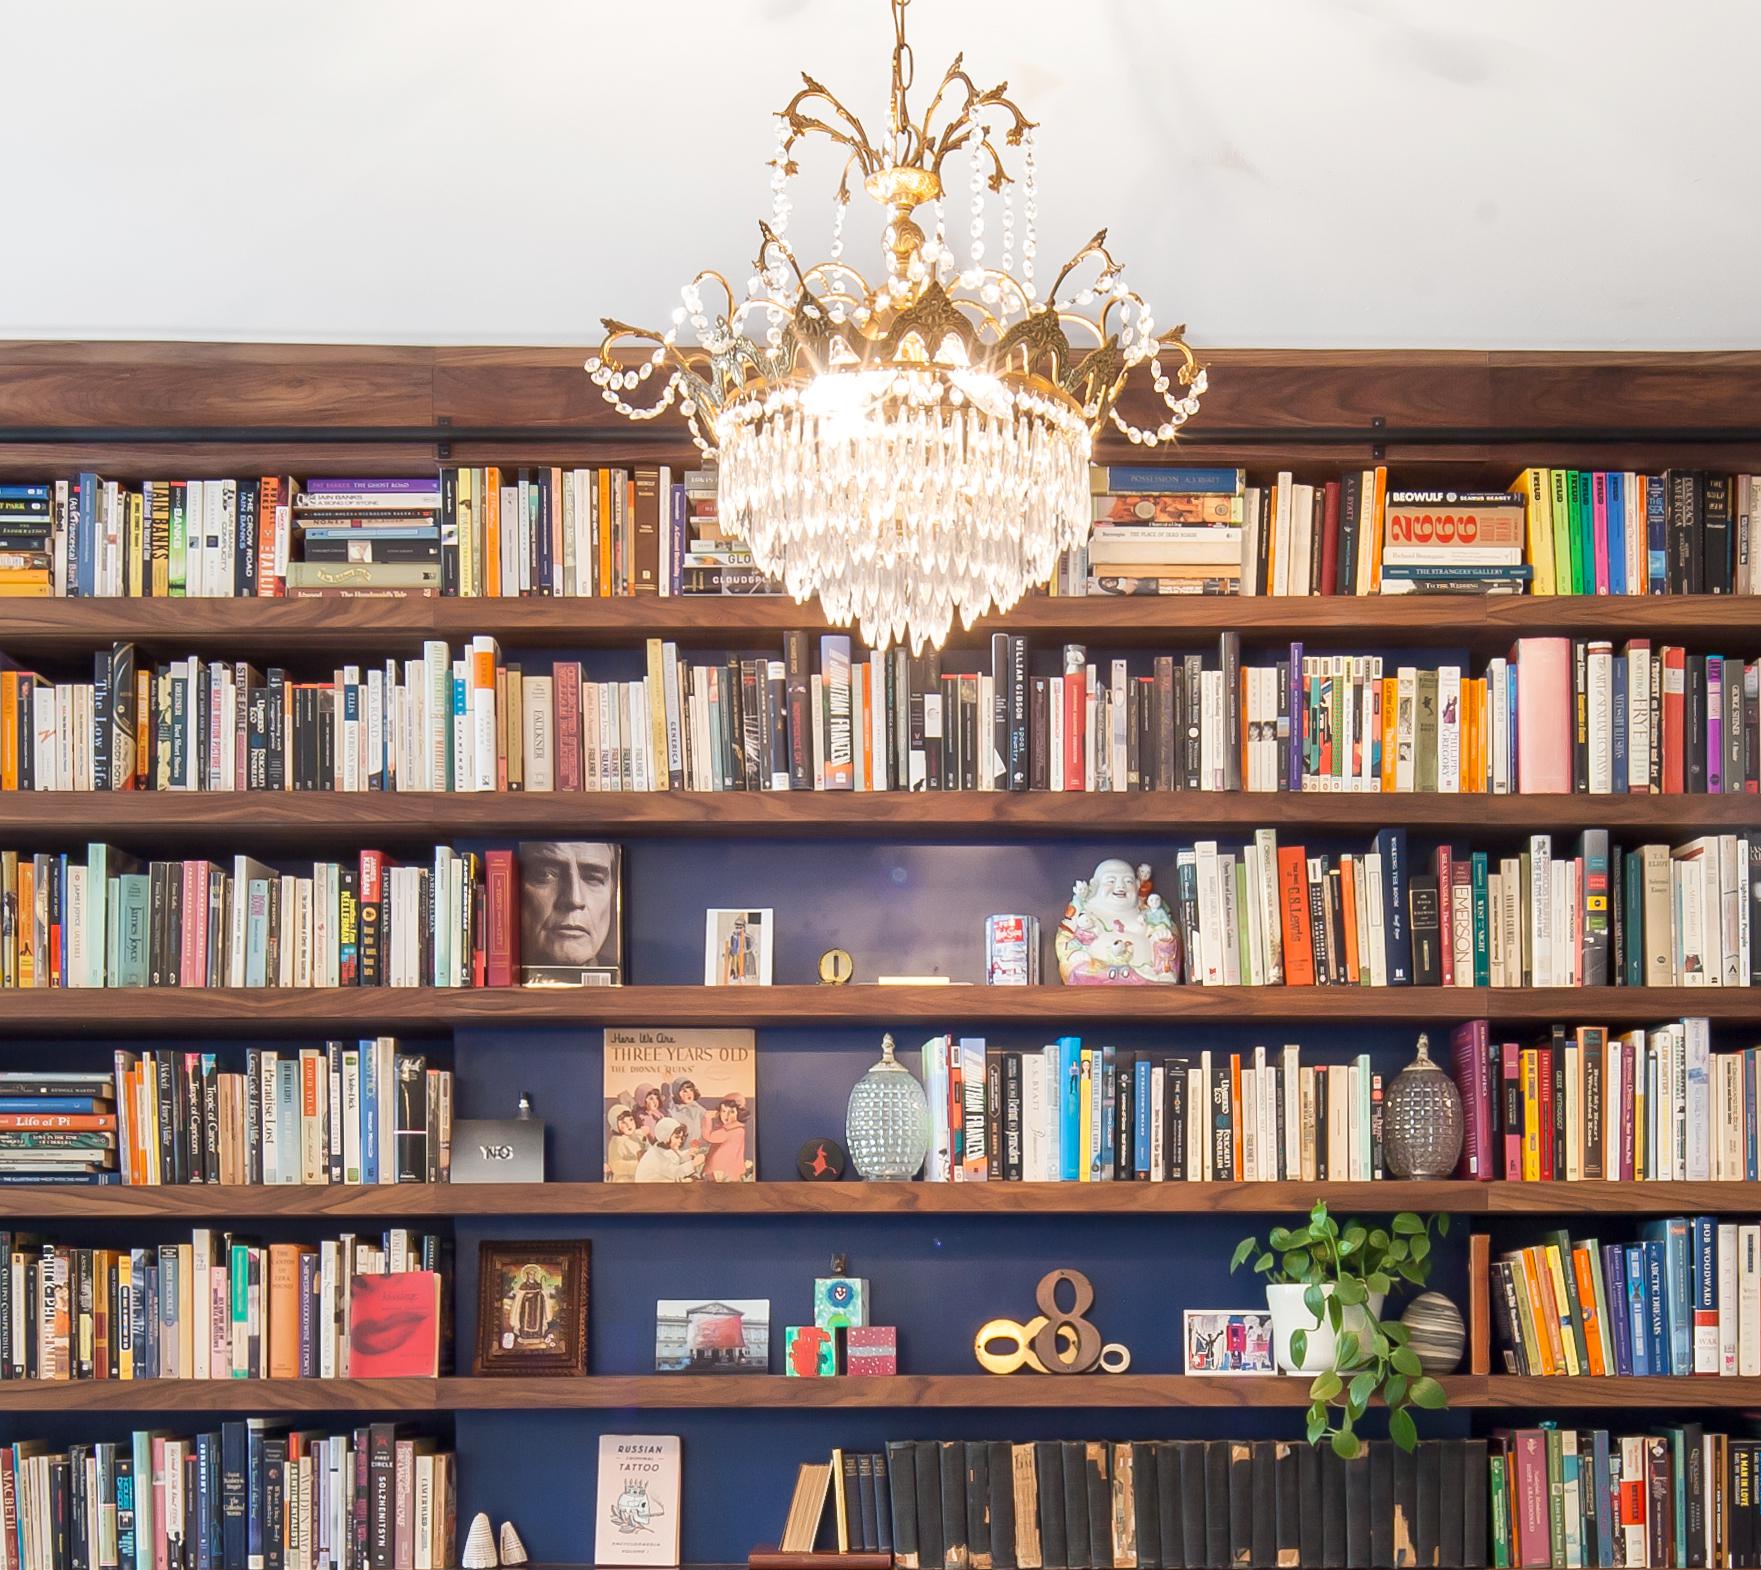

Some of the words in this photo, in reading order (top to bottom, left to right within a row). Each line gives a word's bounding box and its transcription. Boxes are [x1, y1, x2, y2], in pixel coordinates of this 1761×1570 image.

[152, 487, 169, 514] IAIN
[1393, 493, 1443, 502] BEOWULF
[1533, 472, 1542, 500] FREUD
[1556, 474, 1564, 502] FREUD
[1571, 475, 1579, 503] FREUD
[1596, 476, 1604, 504] FREUD
[1675, 478, 1683, 527] AMERICA
[1684, 477, 1693, 526] DEMOCRACY
[152, 518, 169, 559] BANKS
[174, 508, 183, 548] BANKS
[1391, 515, 1477, 543] 2666
[1015, 640, 1023, 681] WILLIAM
[1635, 653, 1644, 697] NORTHROP
[95, 679, 107, 700] The
[237, 667, 245, 696] STEVE
[237, 698, 245, 733] EARLE
[1015, 684, 1023, 719] GIBSON
[95, 717, 107, 746] Low
[1633, 698, 1648, 737] FRYE
[534, 710, 545, 759] FAULKNER
[1441, 729, 1450, 777] GREGORY
[1449, 731, 1458, 776] PHILIPPA
[95, 756, 107, 786] Life
[130, 907, 143, 936] James
[341, 892, 350, 943] KELLERMAN
[1455, 888, 1469, 962] EMERSON
[127, 938, 143, 963] Joyce
[611, 1033, 635, 1043] Here
[640, 1033, 653, 1043] We
[656, 1033, 676, 1043] Are
[614, 1048, 662, 1062] THREE
[665, 1048, 712, 1062] YEARS
[720, 1048, 748, 1062] OLD
[189, 1083, 199, 1103] Tropic
[206, 1086, 217, 1107] Tropic
[264, 1069, 275, 1116] Paradise
[348, 1073, 357, 1109] Moby-Dick
[16, 1116, 40, 1126] Life
[42, 1116, 53, 1126] of
[58, 1116, 70, 1126] Pi
[189, 1106, 199, 1115] of
[206, 1109, 217, 1120] of
[189, 1117, 199, 1154] Capricorn
[206, 1123, 217, 1152] Cancer
[264, 1120, 275, 1144] Lost
[1703, 1224, 1711, 1242] BOB
[1651, 1260, 1661, 1294] ARCTIC
[1703, 1247, 1711, 1305] WOODWARD
[1651, 1297, 1661, 1335] DREAMS
[618, 1445, 663, 1453] RUSSIAN
[619, 1464, 660, 1472] TATTOO
[3, 1471, 16, 1529] MACBETH
[377, 1476, 387, 1547] SOLZHENITSYN
